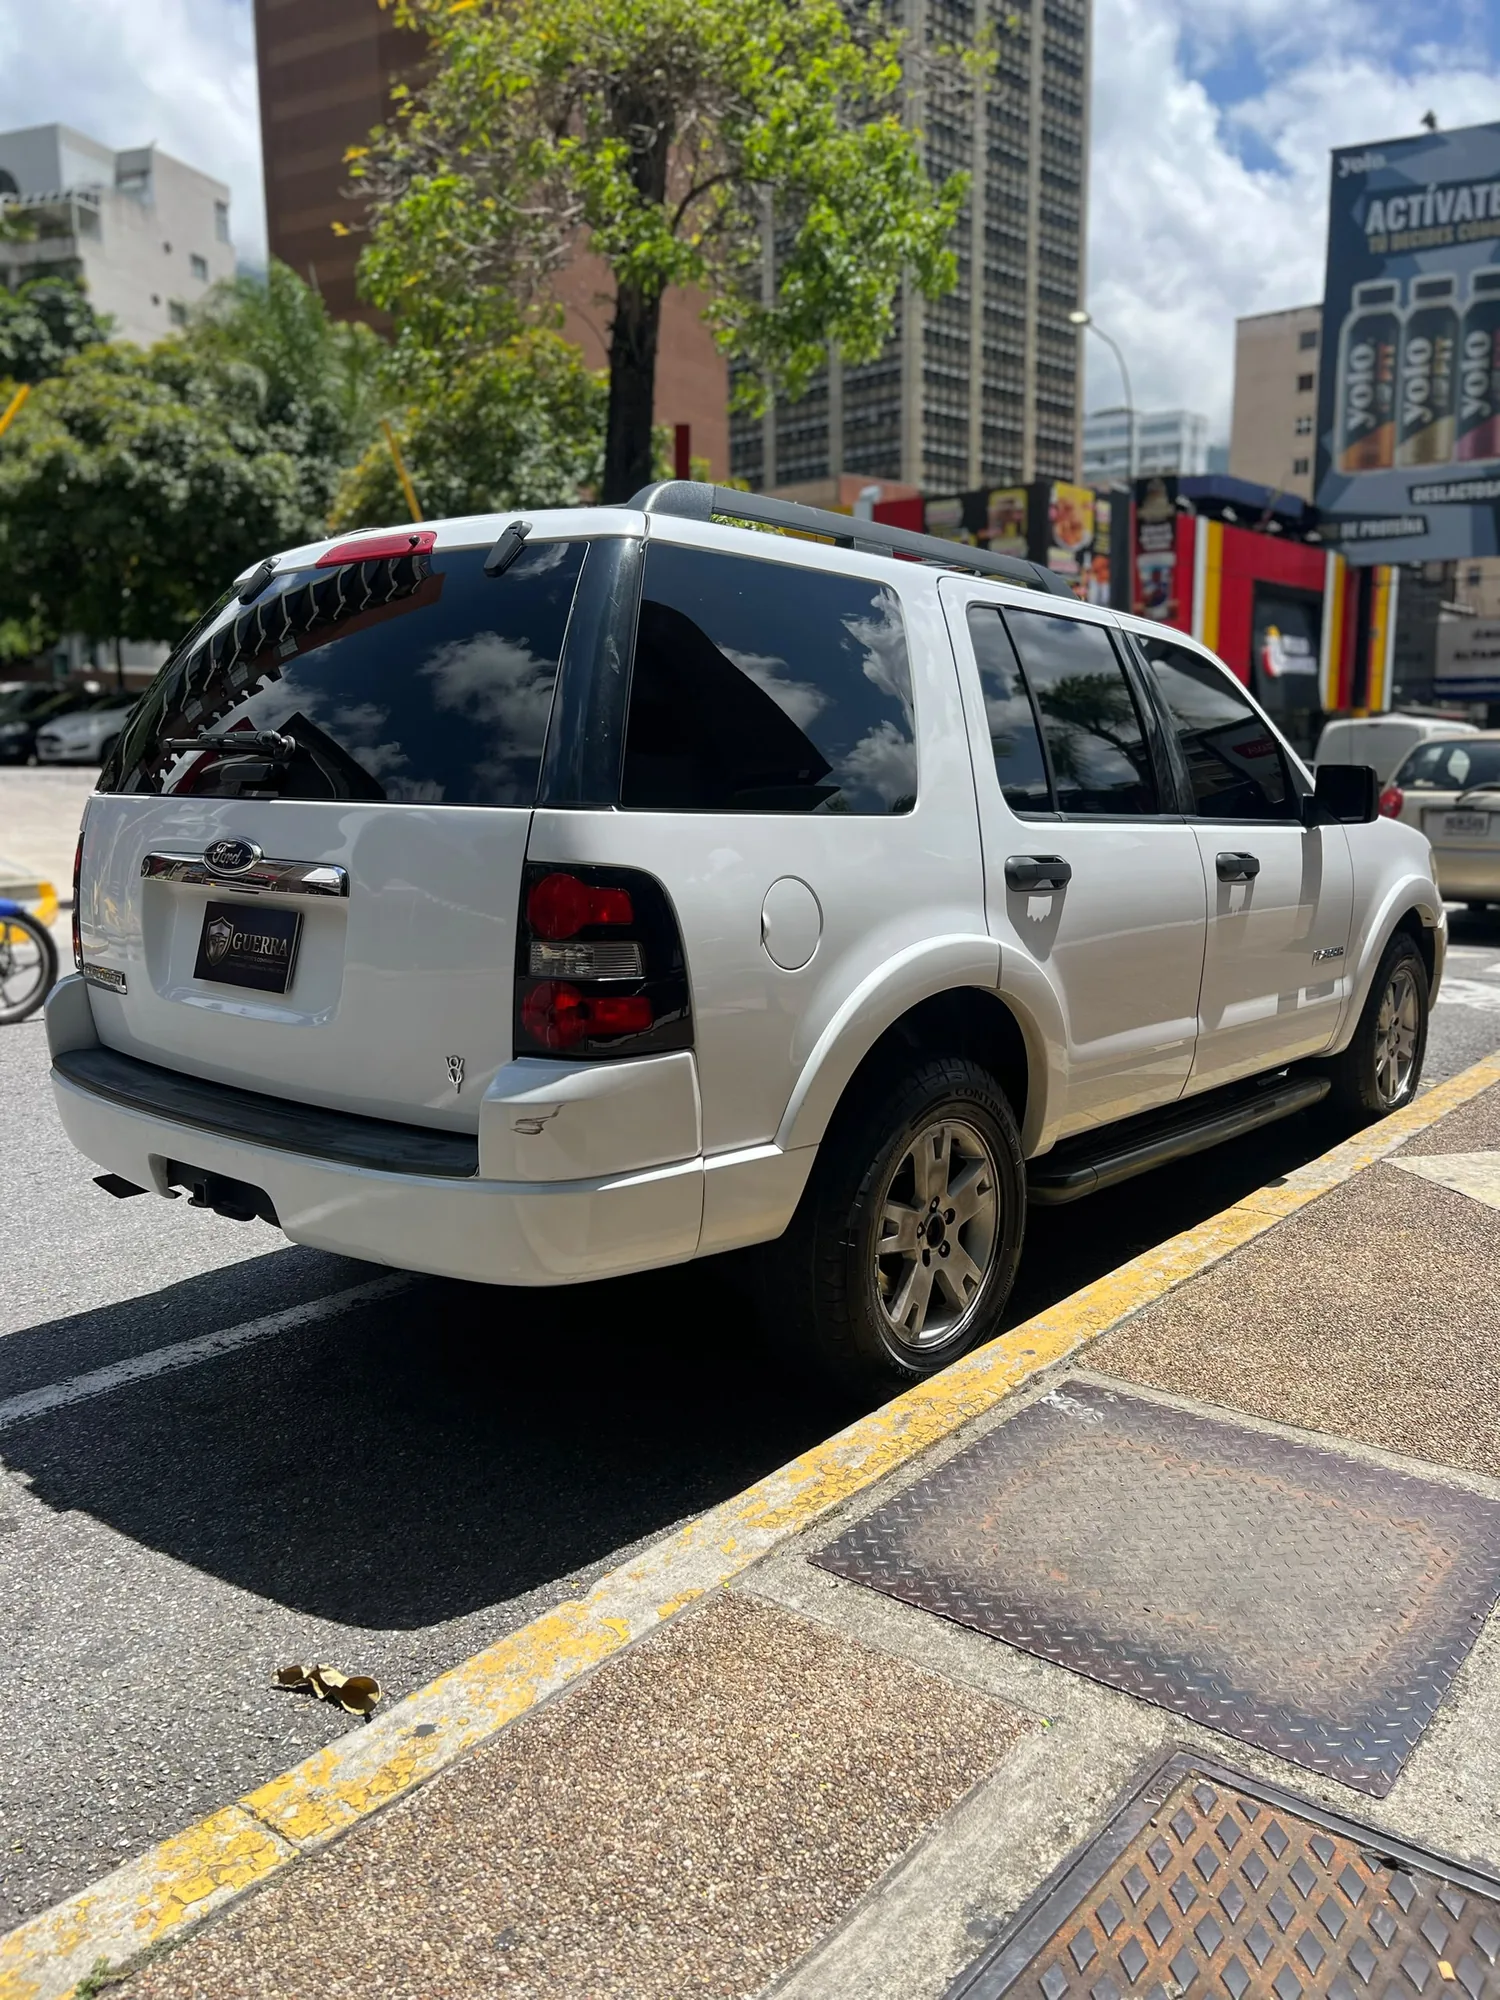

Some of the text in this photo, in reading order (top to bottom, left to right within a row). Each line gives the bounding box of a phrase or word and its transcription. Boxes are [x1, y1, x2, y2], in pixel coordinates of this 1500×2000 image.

[1346, 343, 1376, 430] yolo
[1401, 337, 1432, 426] yolo
[1460, 330, 1491, 420] yolo
[212, 842, 243, 865] Ford
[232, 932, 288, 957] GUERRA
